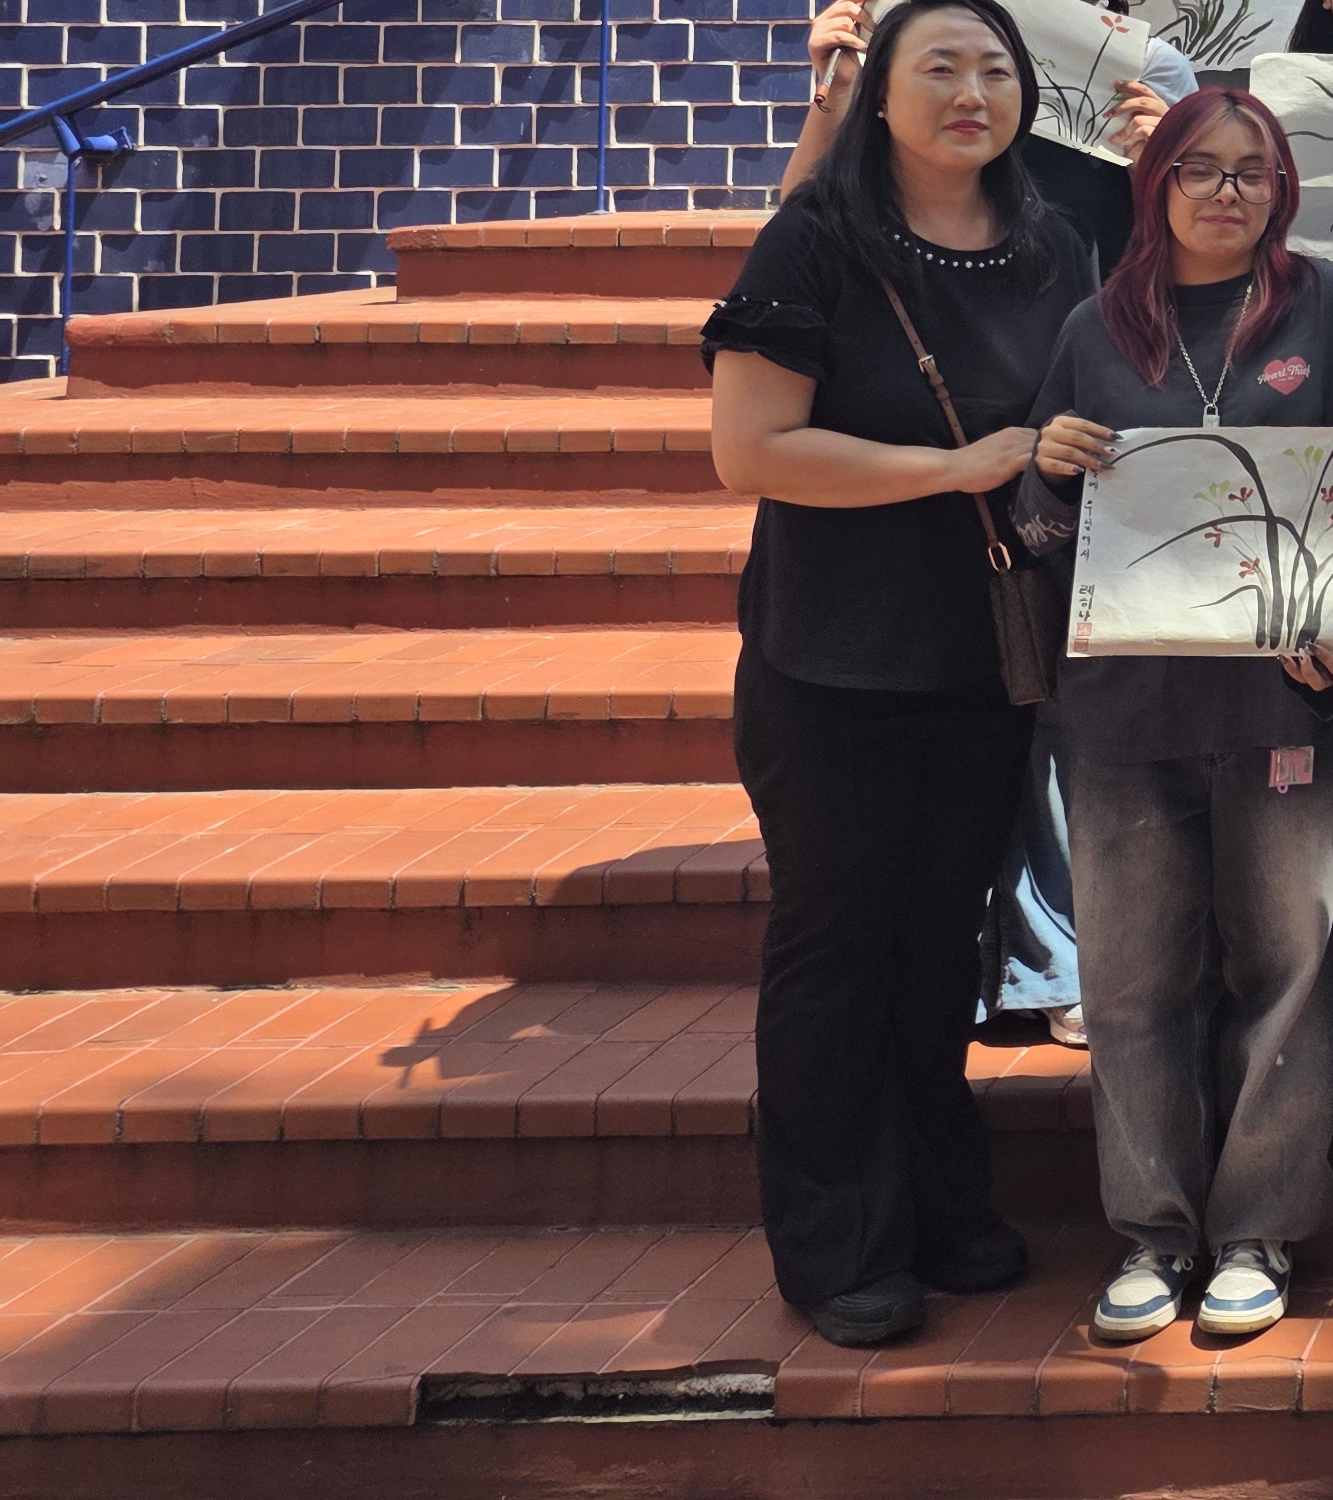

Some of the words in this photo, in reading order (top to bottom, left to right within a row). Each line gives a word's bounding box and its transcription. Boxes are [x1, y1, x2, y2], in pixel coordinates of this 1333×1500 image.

[1256, 368, 1287, 385] Heart
[1287, 363, 1311, 379] Thief
[1077, 583, 1096, 622] 레히나
